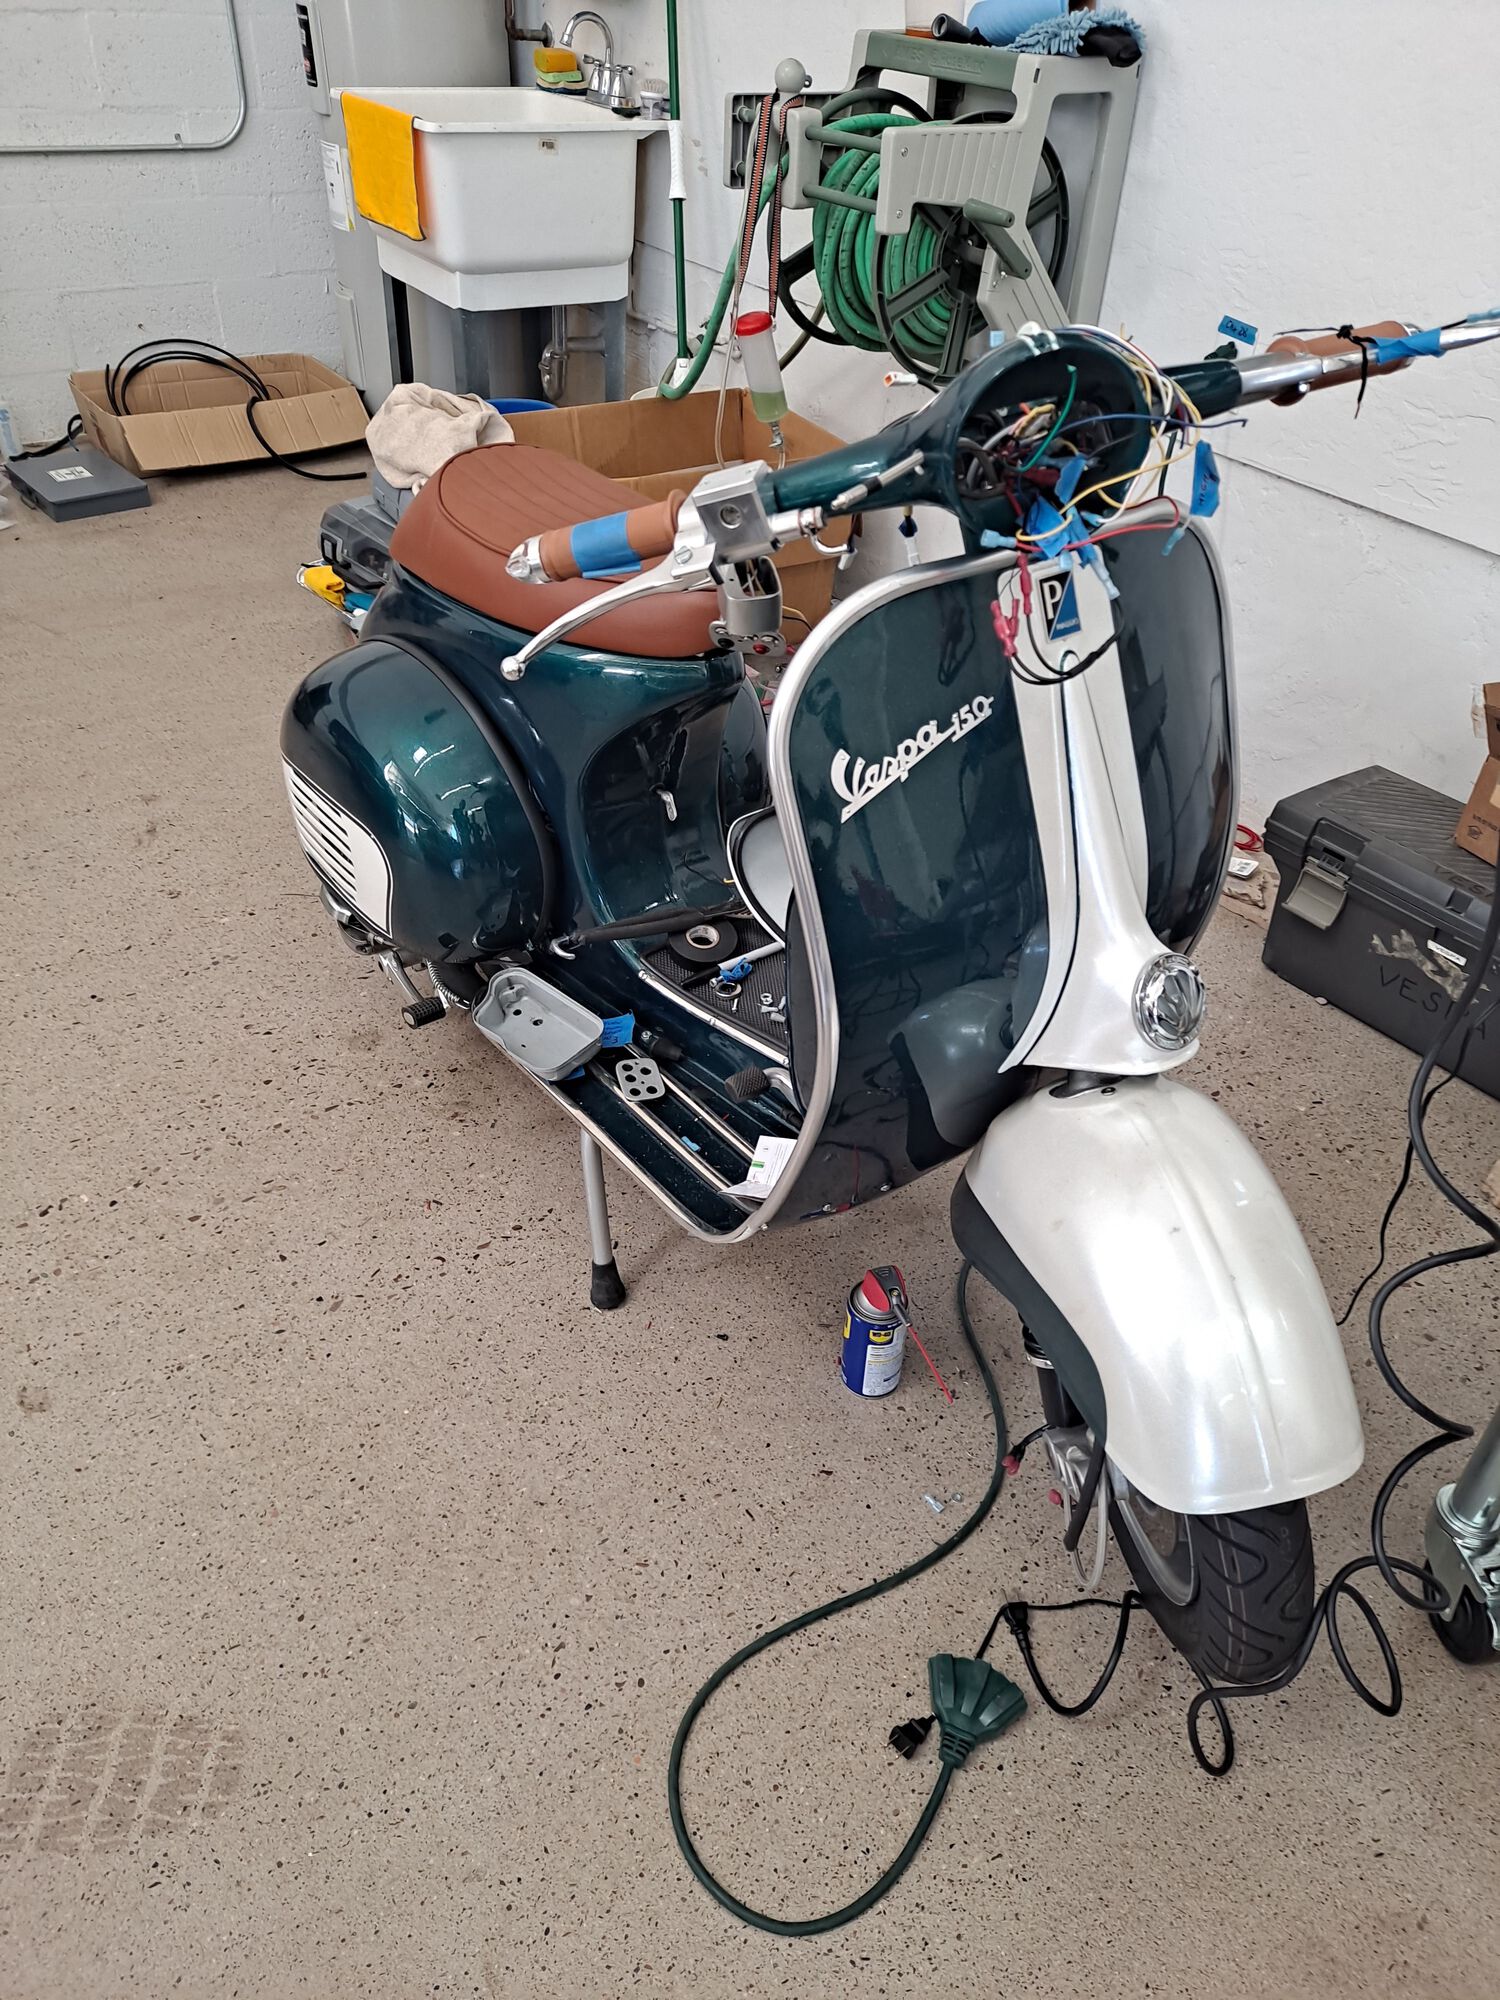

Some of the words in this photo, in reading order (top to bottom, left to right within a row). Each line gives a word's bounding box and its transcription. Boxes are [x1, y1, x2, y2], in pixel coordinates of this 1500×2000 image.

[1042, 581, 1062, 620] P
[831, 720, 943, 824] Vespa
[951, 695, 994, 742] 150
